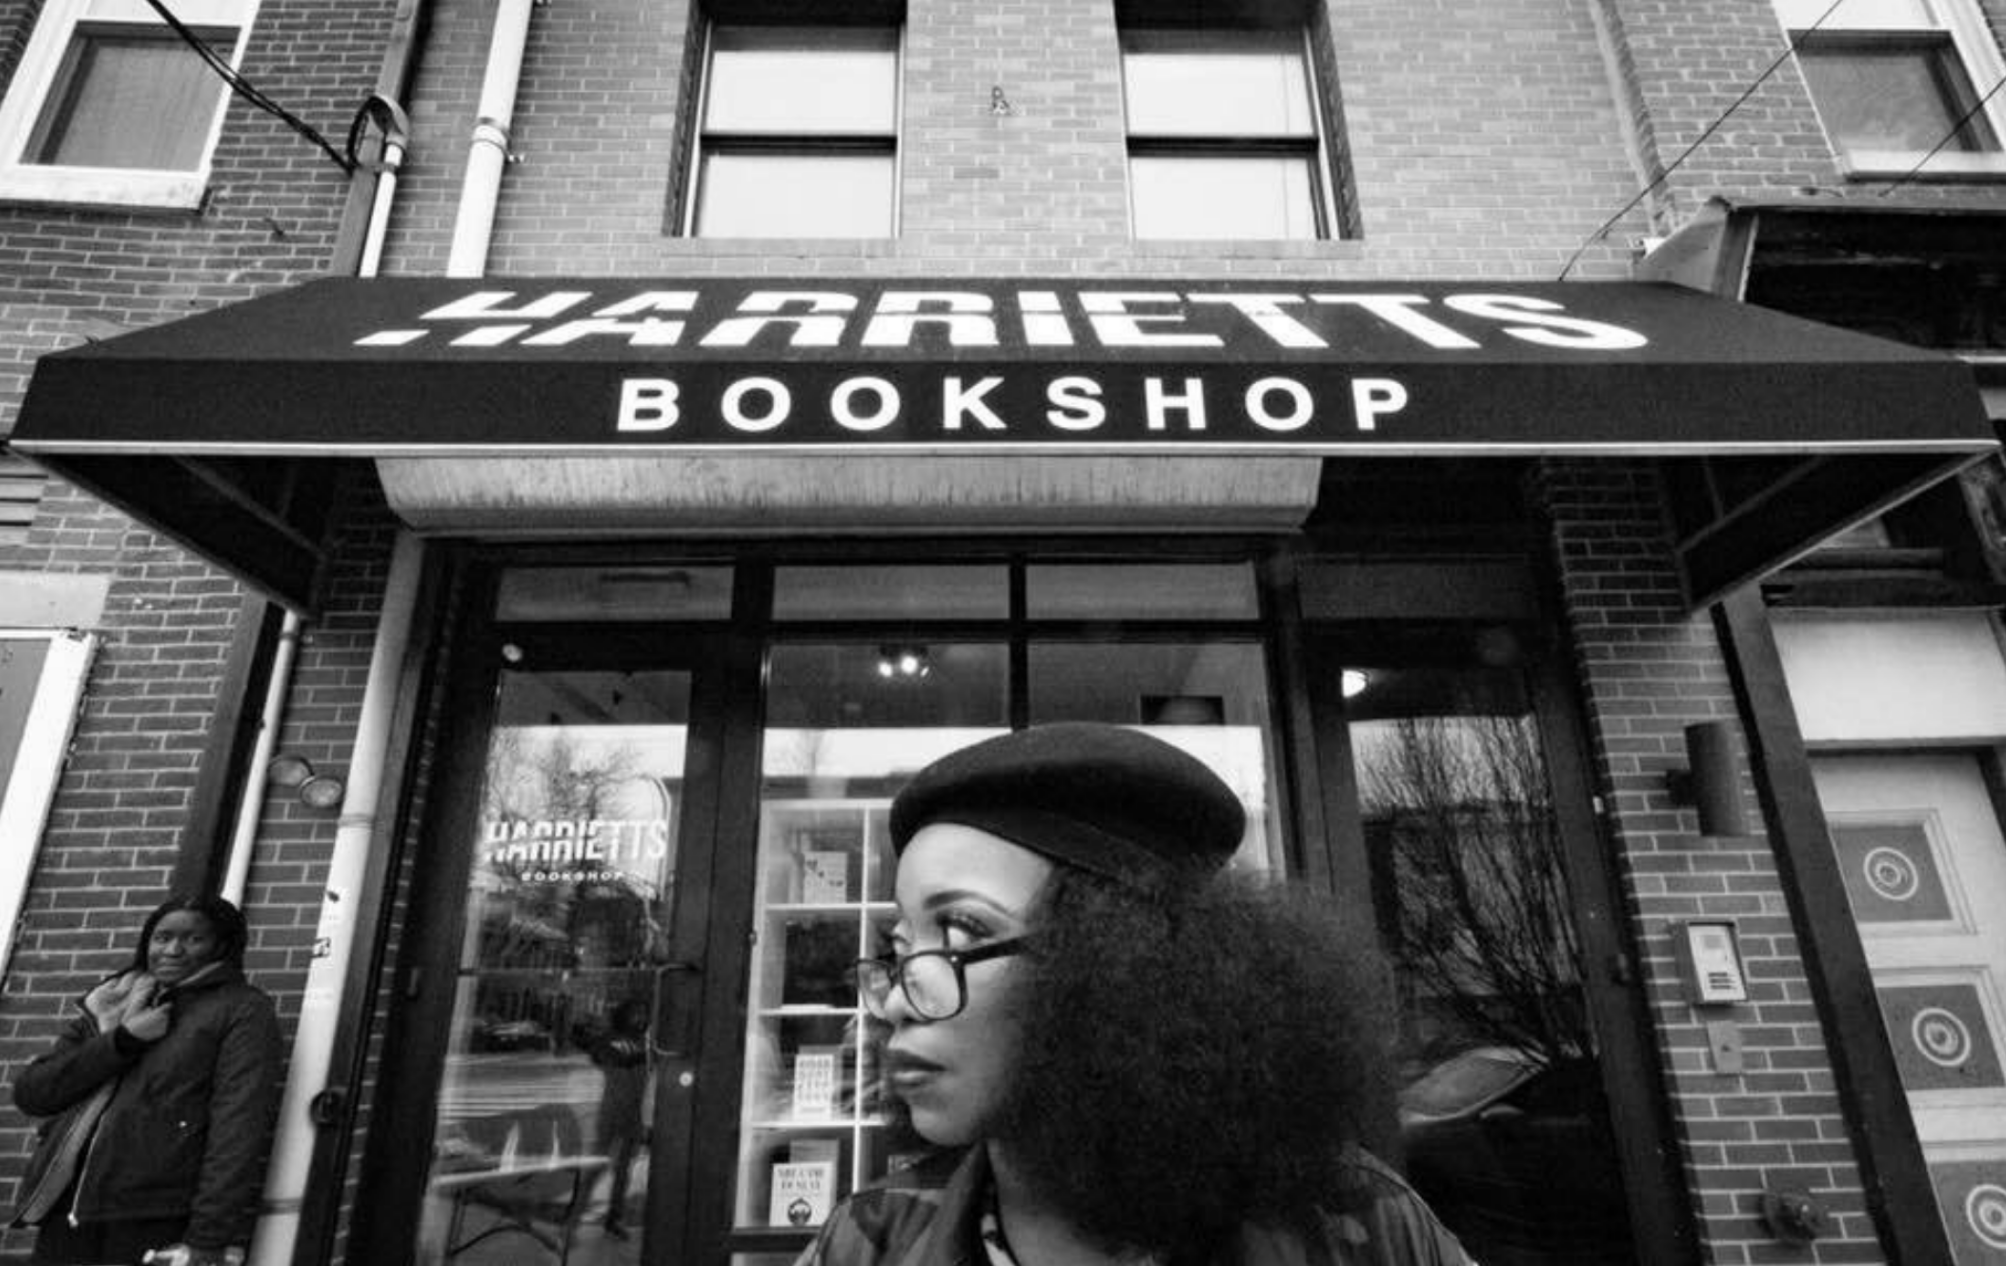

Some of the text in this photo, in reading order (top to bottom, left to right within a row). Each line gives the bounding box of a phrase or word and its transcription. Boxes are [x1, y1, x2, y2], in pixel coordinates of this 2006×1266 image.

[353, 291, 1649, 349] HARRIETTS
[617, 377, 1408, 432] BOOKSHOP
[485, 819, 668, 862] HARRIETTS
[521, 871, 624, 882] BOOKSHOP
